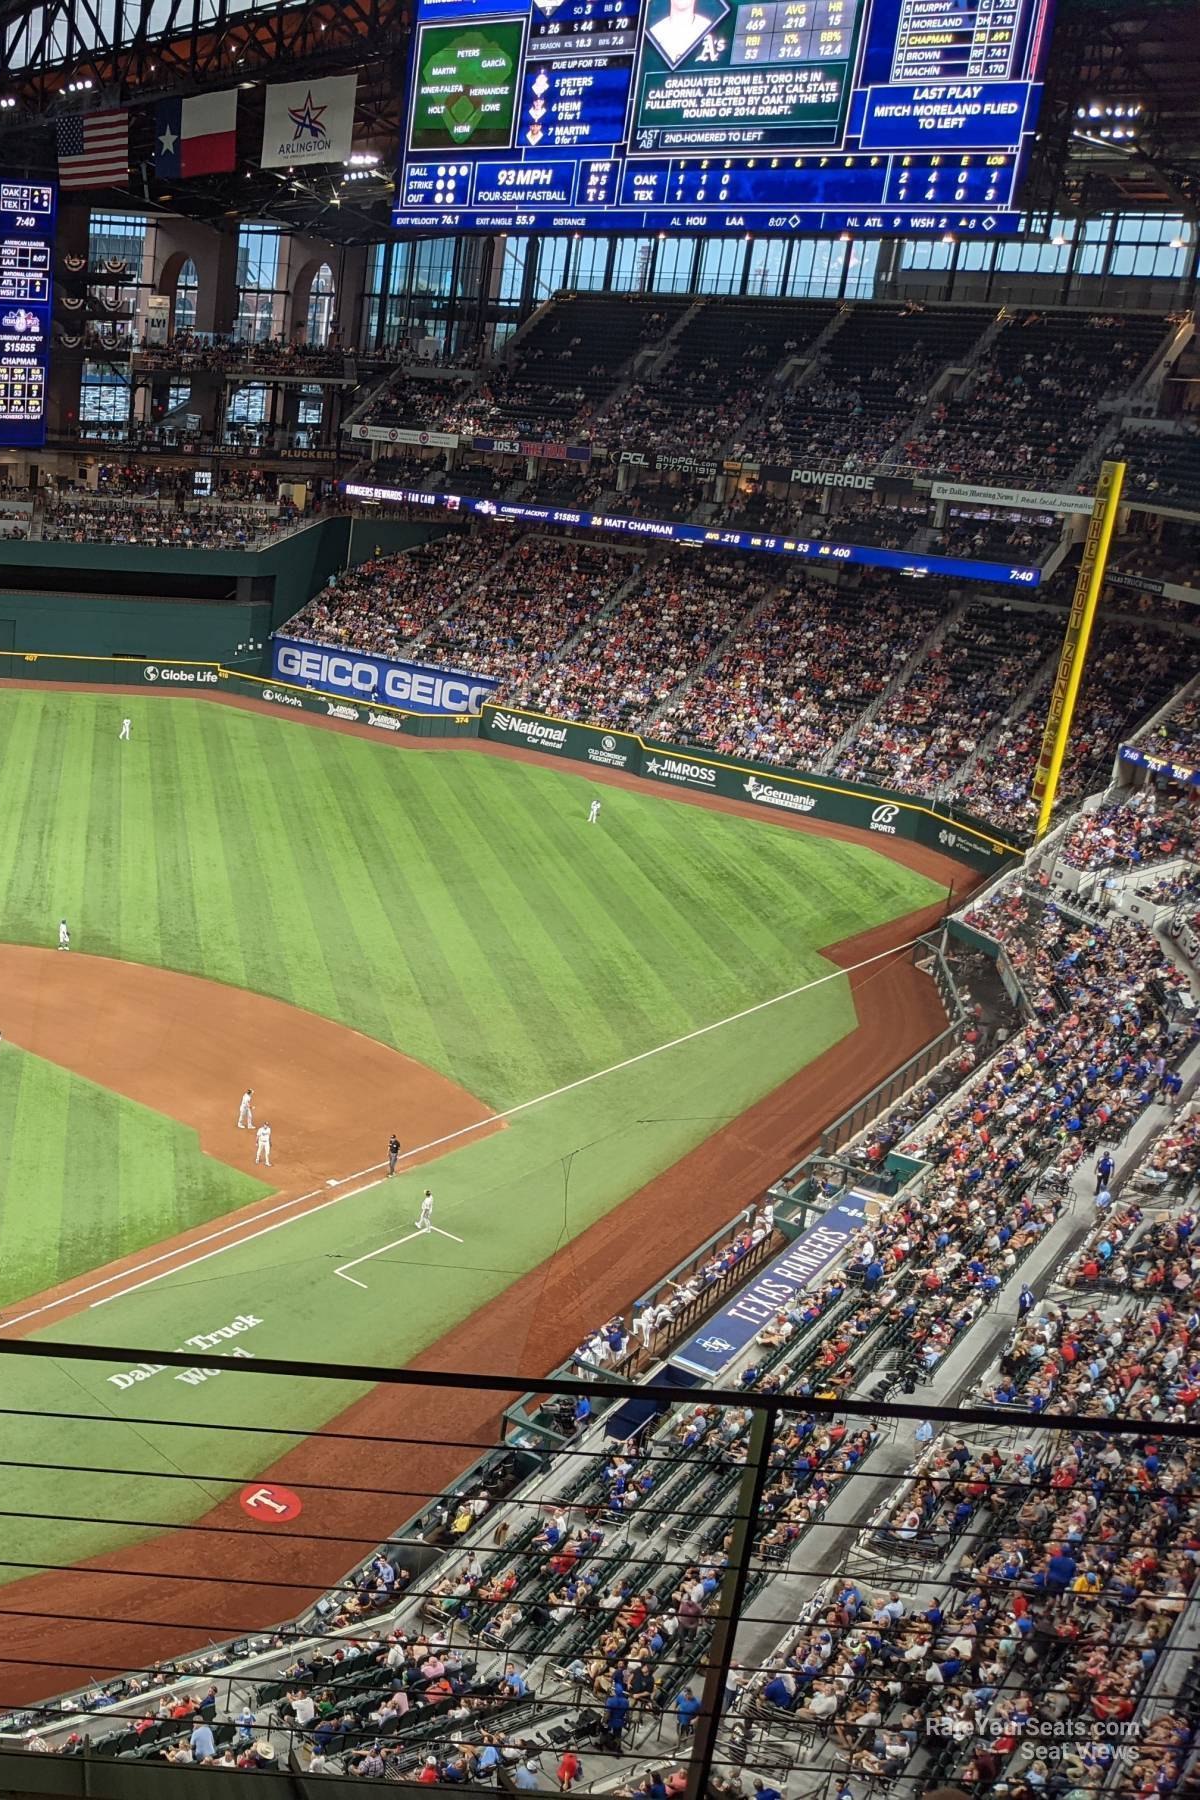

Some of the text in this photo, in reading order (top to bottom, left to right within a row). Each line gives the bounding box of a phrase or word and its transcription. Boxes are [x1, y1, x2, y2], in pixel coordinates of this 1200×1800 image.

[914, 2, 952, 12] MURPHY
[912, 18, 962, 28] MORELAND
[908, 34, 952, 44] CHAPMAN
[457, 49, 480, 58] PETERS
[906, 50, 940, 60] BROWN
[432, 67, 456, 76] MARTIN
[665, 72, 822, 89] GRADUATED FROM EL TORO HS IN
[421, 84, 463, 94] KINER-FALEFA
[470, 86, 509, 96] HERNANDEZ
[649, 82, 836, 100] CALIFORNIA. ALL-BIG WEST AT CAL STATE
[913, 86, 983, 100] LAST PLAY
[481, 104, 500, 112] LOWE
[645, 93, 838, 110] FULLERTON. SELECTED BY OAK IN THE 1ST
[428, 106, 445, 114] HOLT
[683, 105, 792, 119] ROUND OF 2014 DRAFT.
[874, 102, 1018, 118] MITCH MORELAND FLIED
[454, 126, 470, 134] HEIM
[918, 118, 966, 129] TO LEFT
[278, 140, 331, 155] ARLINGTON
[498, 170, 552, 186] 93 MPH
[478, 190, 566, 201] FOUR-SEAM FASTBALL
[2, 358, 38, 366] CHAPMAN
[492, 440, 520, 453] 105.3
[281, 448, 337, 460] PLUCKERS
[620, 452, 650, 466] PGL
[791, 470, 876, 490] POWERADE
[501, 506, 580, 523] CURRENT JACKPOT $15855
[592, 516, 673, 535] 26 MATT CHAPMAN
[1008, 570, 1033, 582] 7:40
[160, 668, 218, 683] Globe Life
[277, 646, 380, 692] GEICO
[274, 692, 302, 708] Kubota
[527, 736, 563, 750] Car Rental
[764, 786, 817, 808] Germania
[870, 822, 896, 834] SPORTS
[726, 1226, 848, 1325] TEXAS RANGERS
[184, 1314, 264, 1351] Truck
[246, 1488, 288, 1514] T
